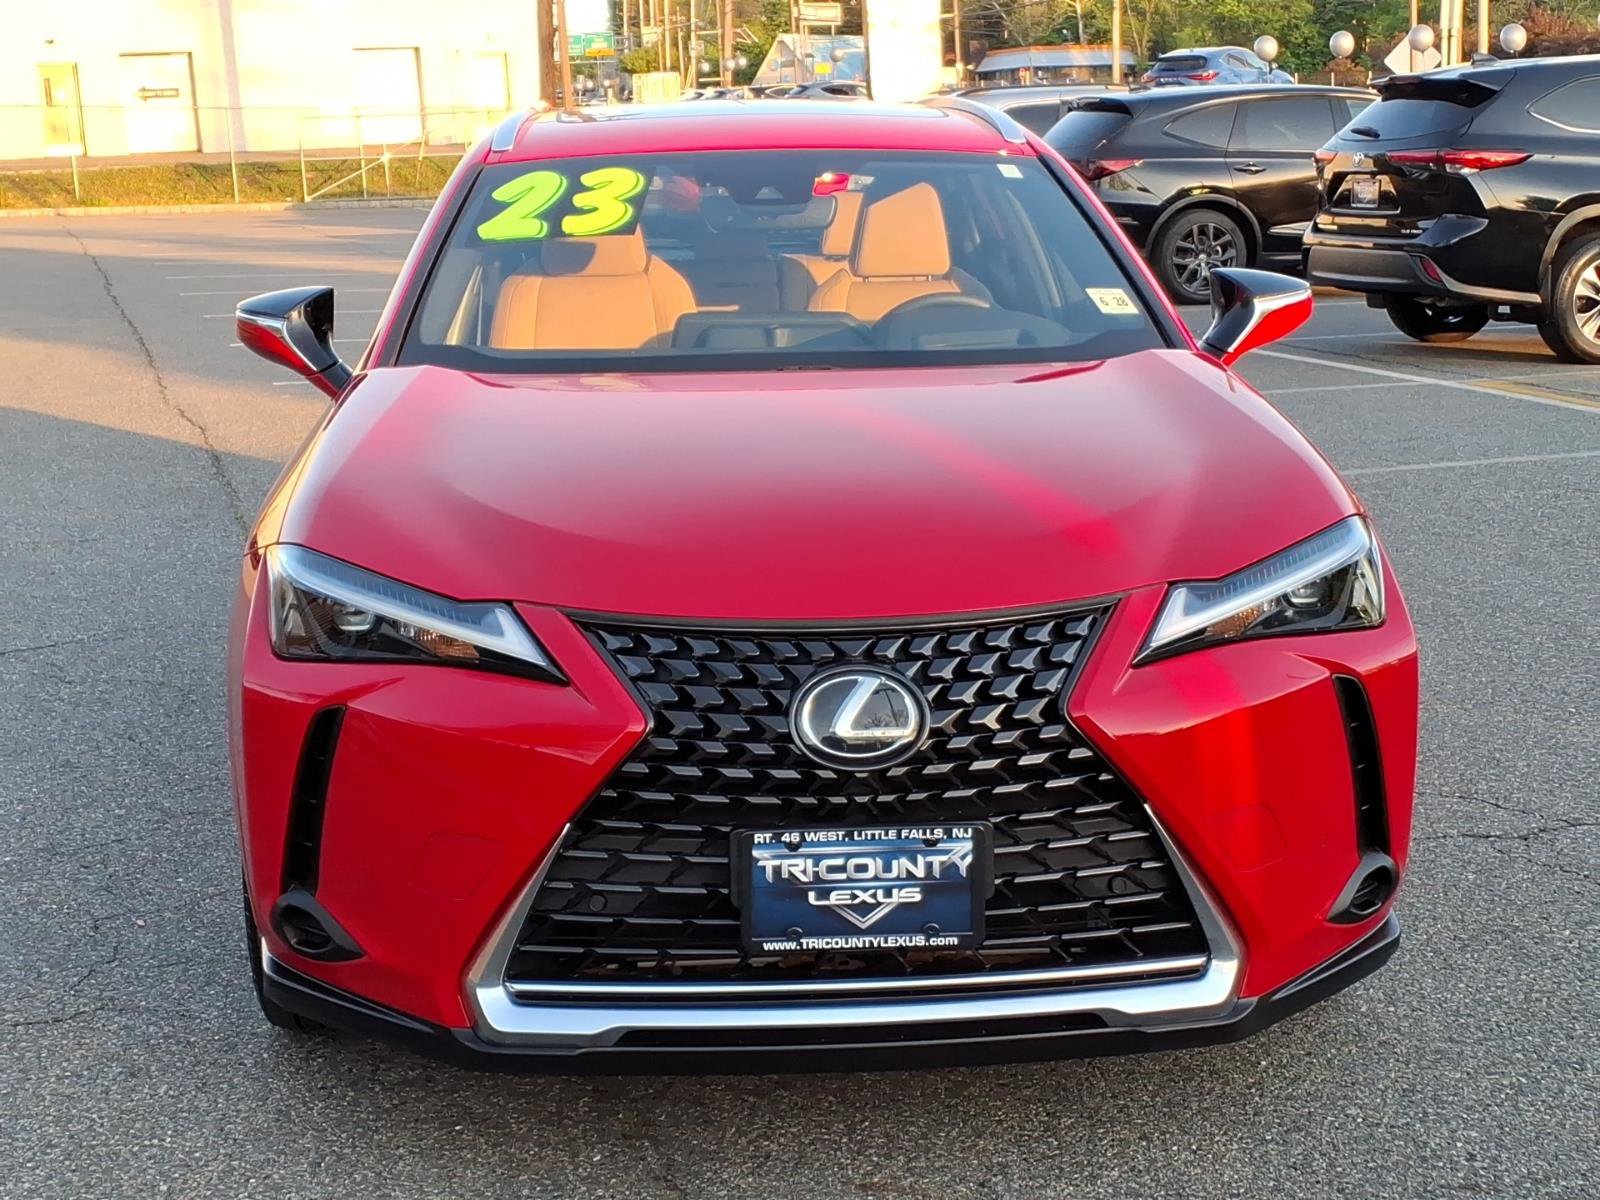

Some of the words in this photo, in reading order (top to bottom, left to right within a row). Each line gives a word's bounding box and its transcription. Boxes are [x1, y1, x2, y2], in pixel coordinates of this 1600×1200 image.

[477, 167, 644, 240] 23
[754, 833, 775, 844] RT.
[781, 832, 800, 842] 46
[804, 831, 849, 842] WEST,
[853, 829, 897, 840] LITTLE
[901, 828, 947, 840] FALLS,
[951, 828, 972, 839] NJ
[807, 887, 922, 905] LEXUS
[763, 935, 958, 951] www.TRICOUNTYLEXUS.com
